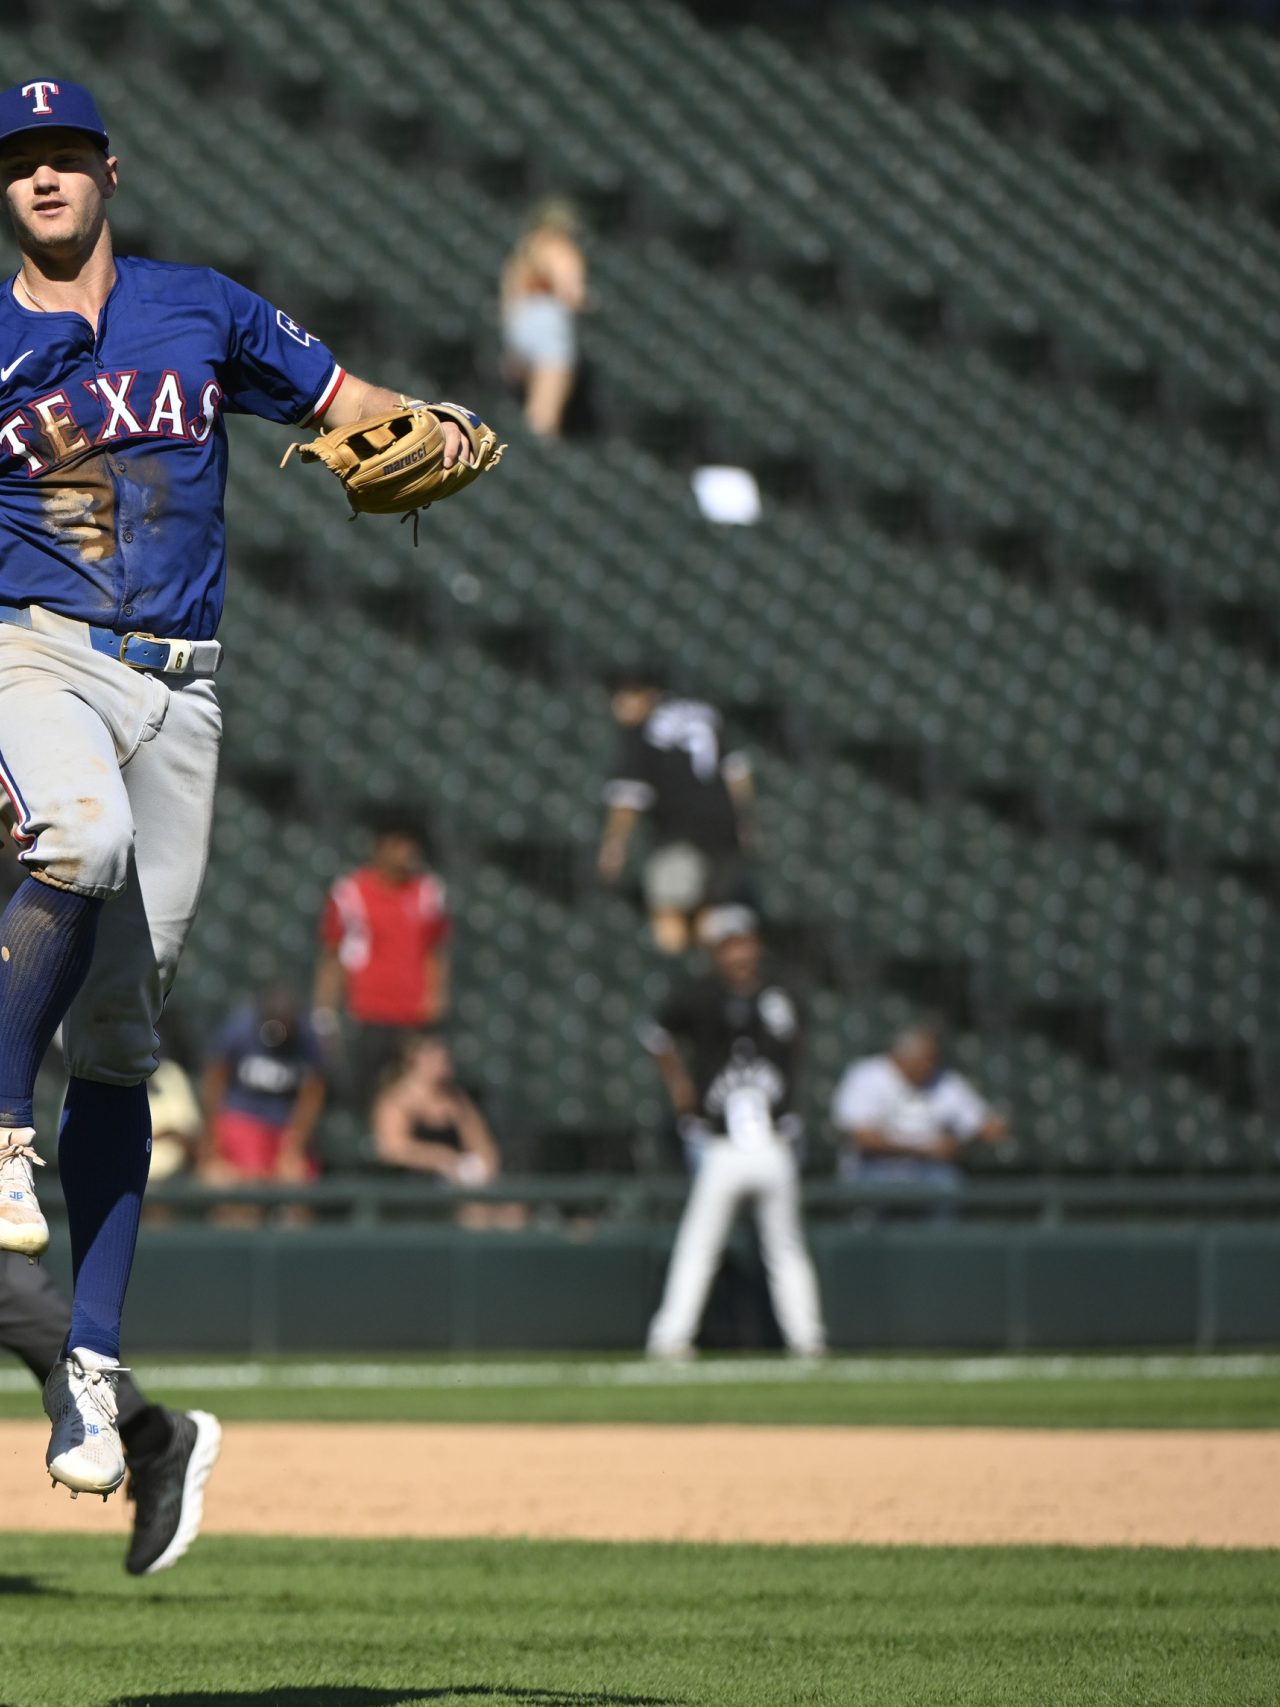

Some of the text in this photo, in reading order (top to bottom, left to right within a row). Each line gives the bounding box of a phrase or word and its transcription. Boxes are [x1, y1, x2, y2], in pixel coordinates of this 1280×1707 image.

[22, 81, 59, 115] T
[383, 442, 427, 475] marucci
[175, 651, 184, 669] 6
